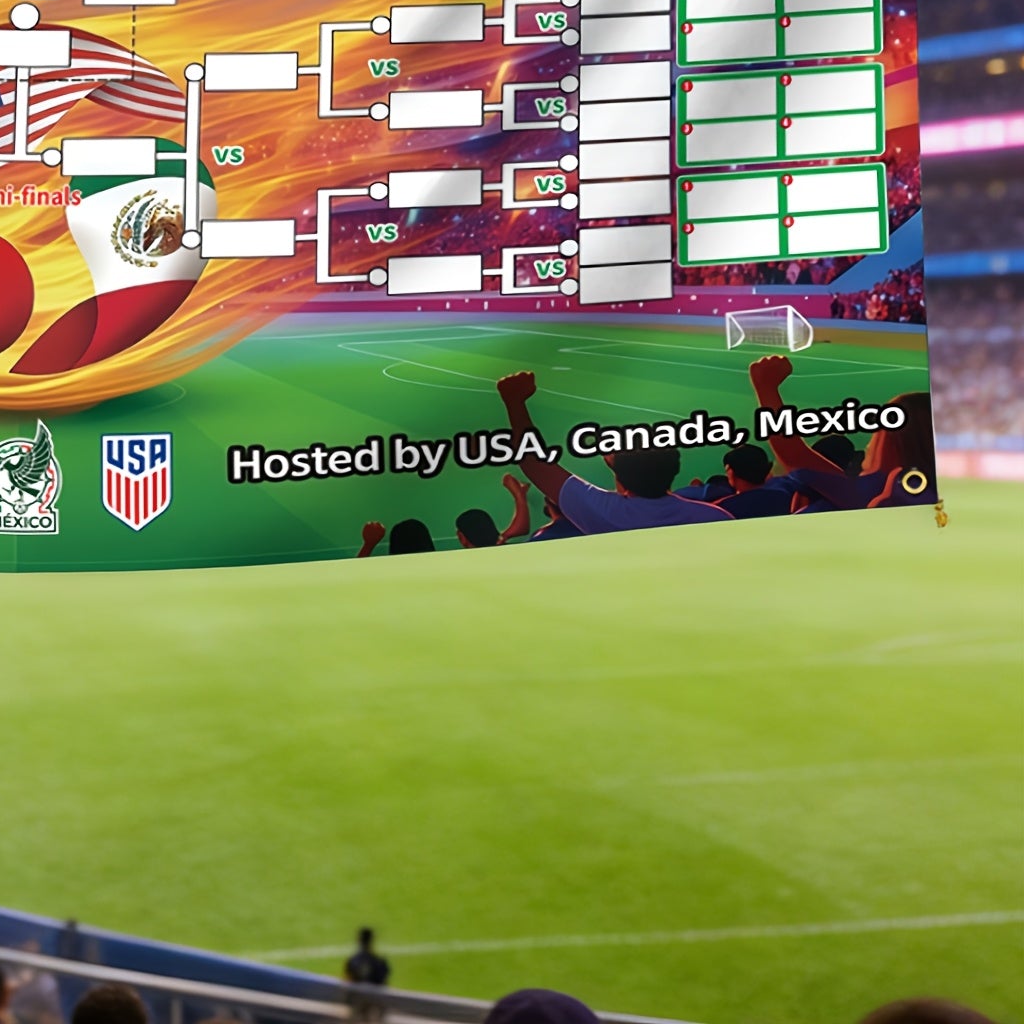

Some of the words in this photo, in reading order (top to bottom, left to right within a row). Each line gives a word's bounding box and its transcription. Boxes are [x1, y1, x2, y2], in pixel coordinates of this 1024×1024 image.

[106, 438, 167, 476] USA
[232, 440, 380, 480] Hosted
[394, 438, 446, 475] by
[458, 431, 559, 465] USA,
[572, 414, 745, 455] Canada,
[758, 402, 906, 438] Mexico
